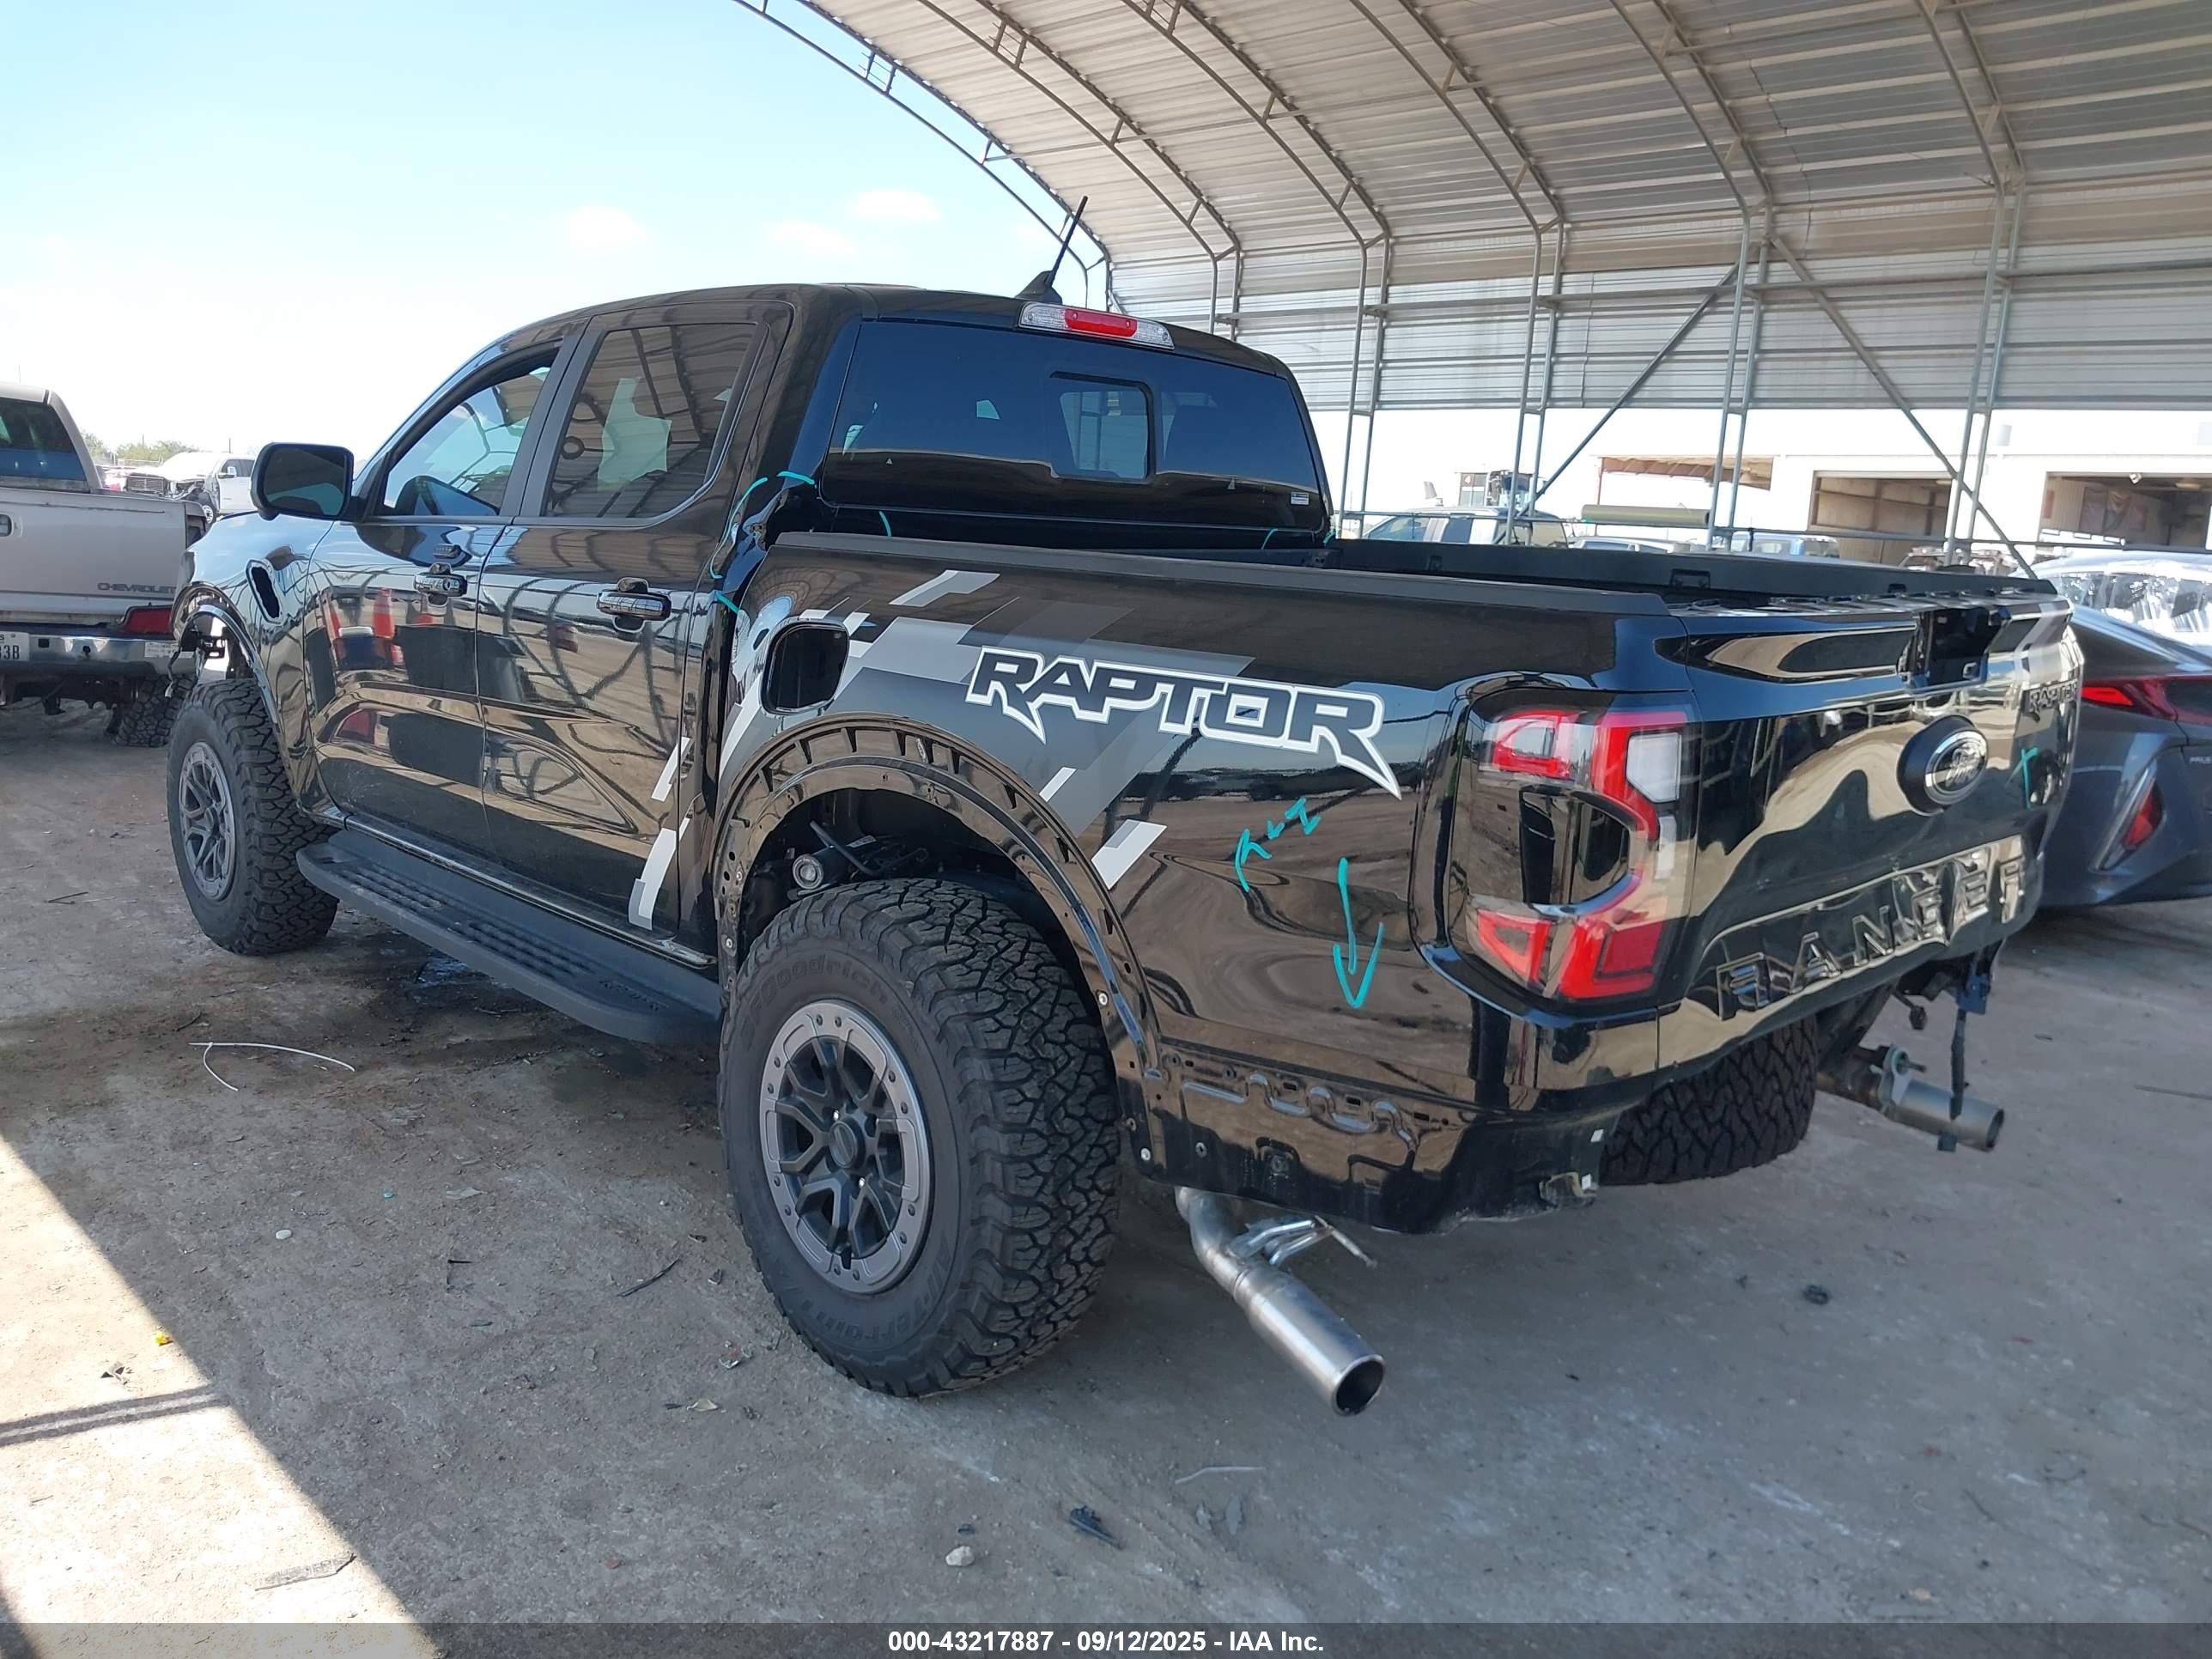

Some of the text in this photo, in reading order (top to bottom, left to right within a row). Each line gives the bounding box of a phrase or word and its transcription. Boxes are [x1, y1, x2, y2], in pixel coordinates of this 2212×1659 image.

[0, 644, 20, 660] 3B
[965, 645, 1401, 800] RAPTOR
[1717, 859, 2027, 1022] RANGER
